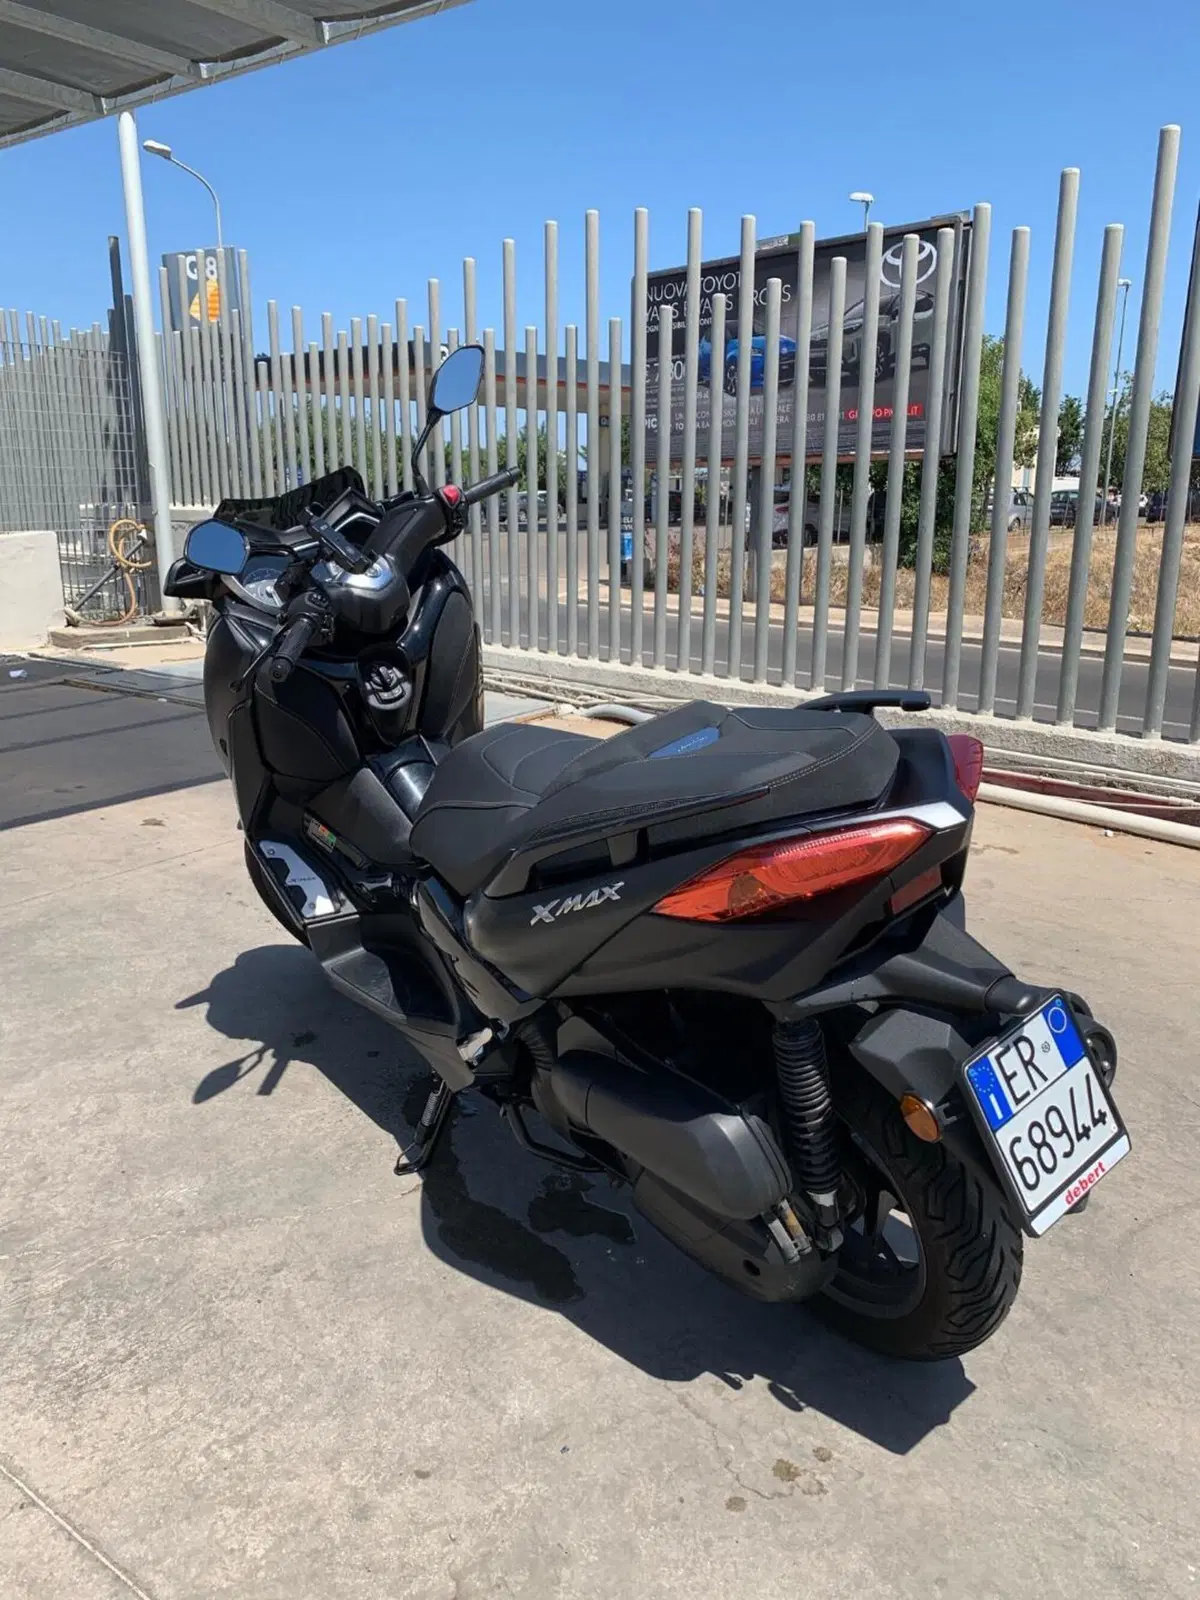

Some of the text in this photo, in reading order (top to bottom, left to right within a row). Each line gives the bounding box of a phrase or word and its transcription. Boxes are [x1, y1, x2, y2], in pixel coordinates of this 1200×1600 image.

[994, 1035, 1048, 1106] ER
[1010, 1073, 1107, 1191] 68944
[1064, 1161, 1106, 1205] debert
